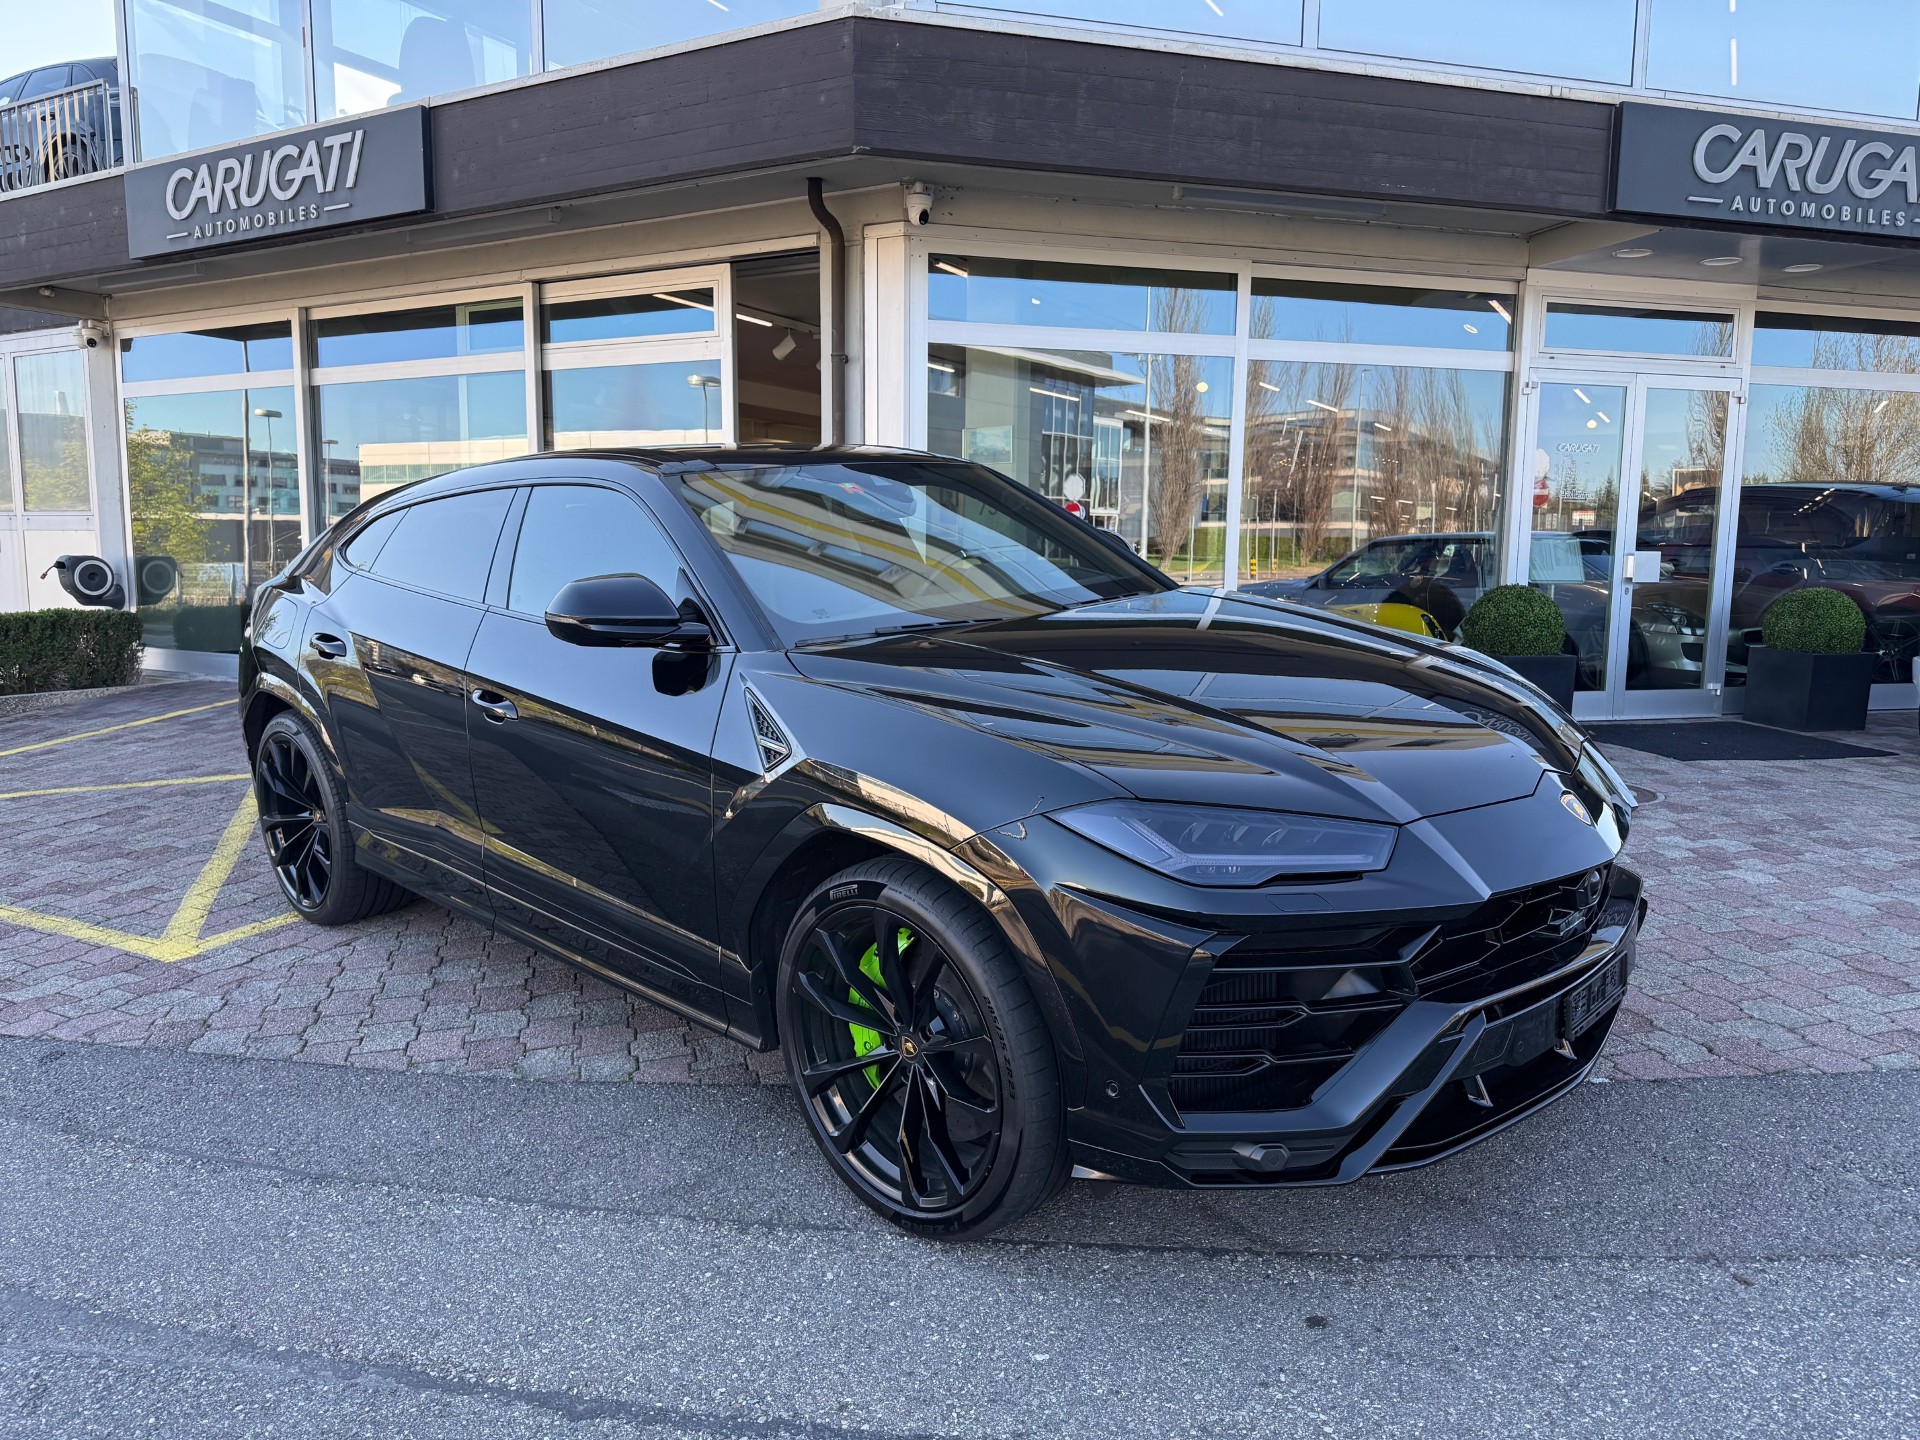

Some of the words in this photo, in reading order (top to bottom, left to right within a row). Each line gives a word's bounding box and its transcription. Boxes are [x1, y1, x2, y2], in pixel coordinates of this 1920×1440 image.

[165, 129, 365, 220] CARUGATI
[1692, 123, 1920, 204] CARUGA
[193, 203, 320, 239] AUTOMOBILES
[1730, 195, 1906, 227] AUTOMOBILES
[1558, 443, 1600, 453] CARUGATI
[829, 884, 858, 901] PIRELLI
